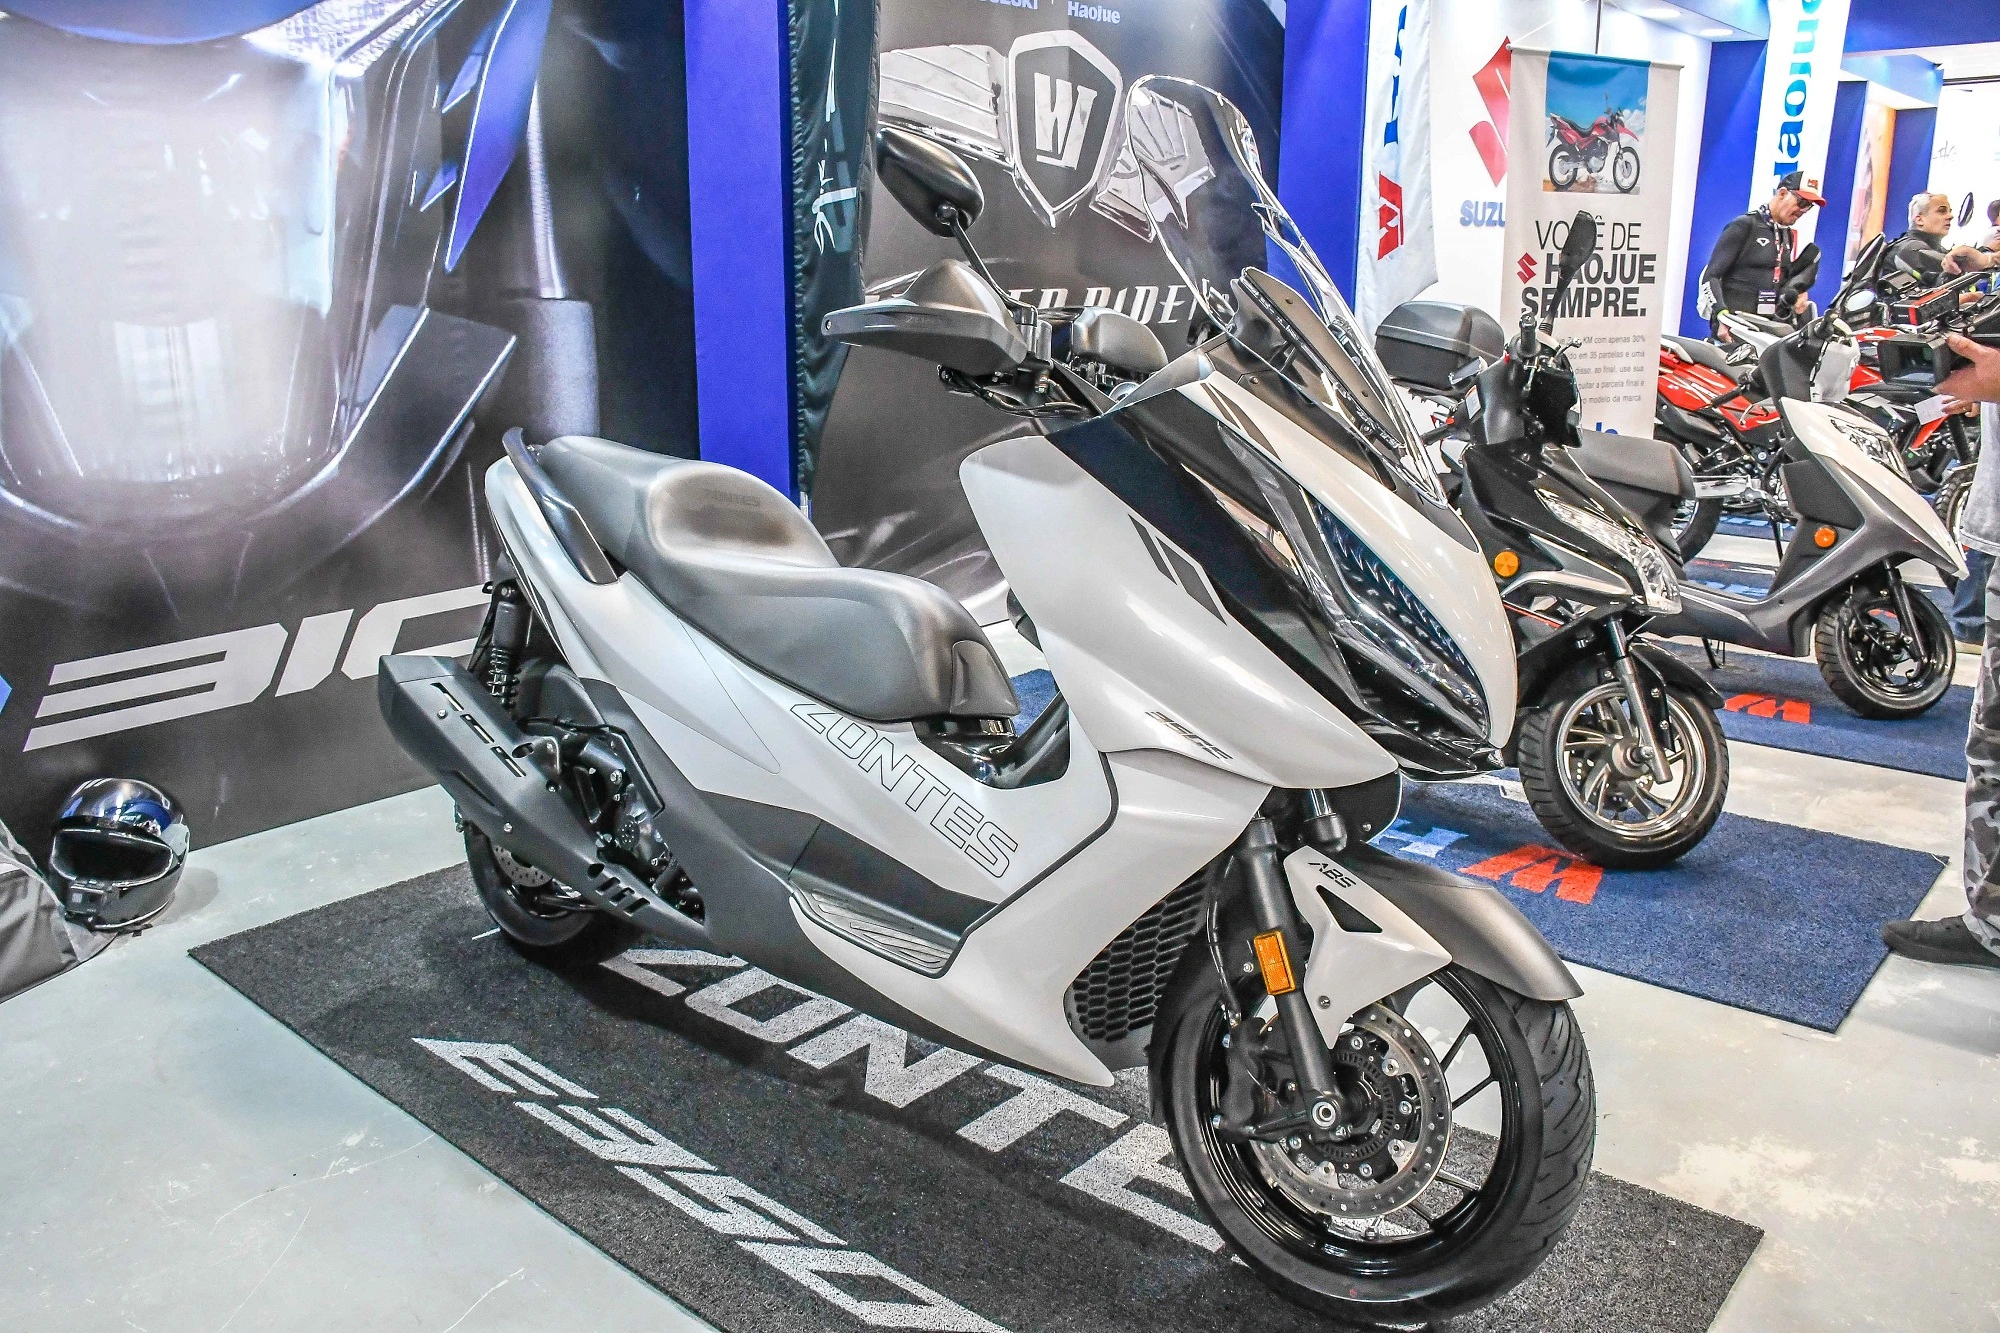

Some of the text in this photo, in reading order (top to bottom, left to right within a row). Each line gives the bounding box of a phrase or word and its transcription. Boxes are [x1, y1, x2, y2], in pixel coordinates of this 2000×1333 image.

[1067, 1, 1121, 24] Haojue
[1460, 199, 1506, 228] SUZU
[1535, 215, 1641, 251] VOÊ DE
[789, 703, 1019, 878] ZONTES
[1307, 862, 1357, 889] ABS
[600, 947, 1248, 1268] ZONTE
